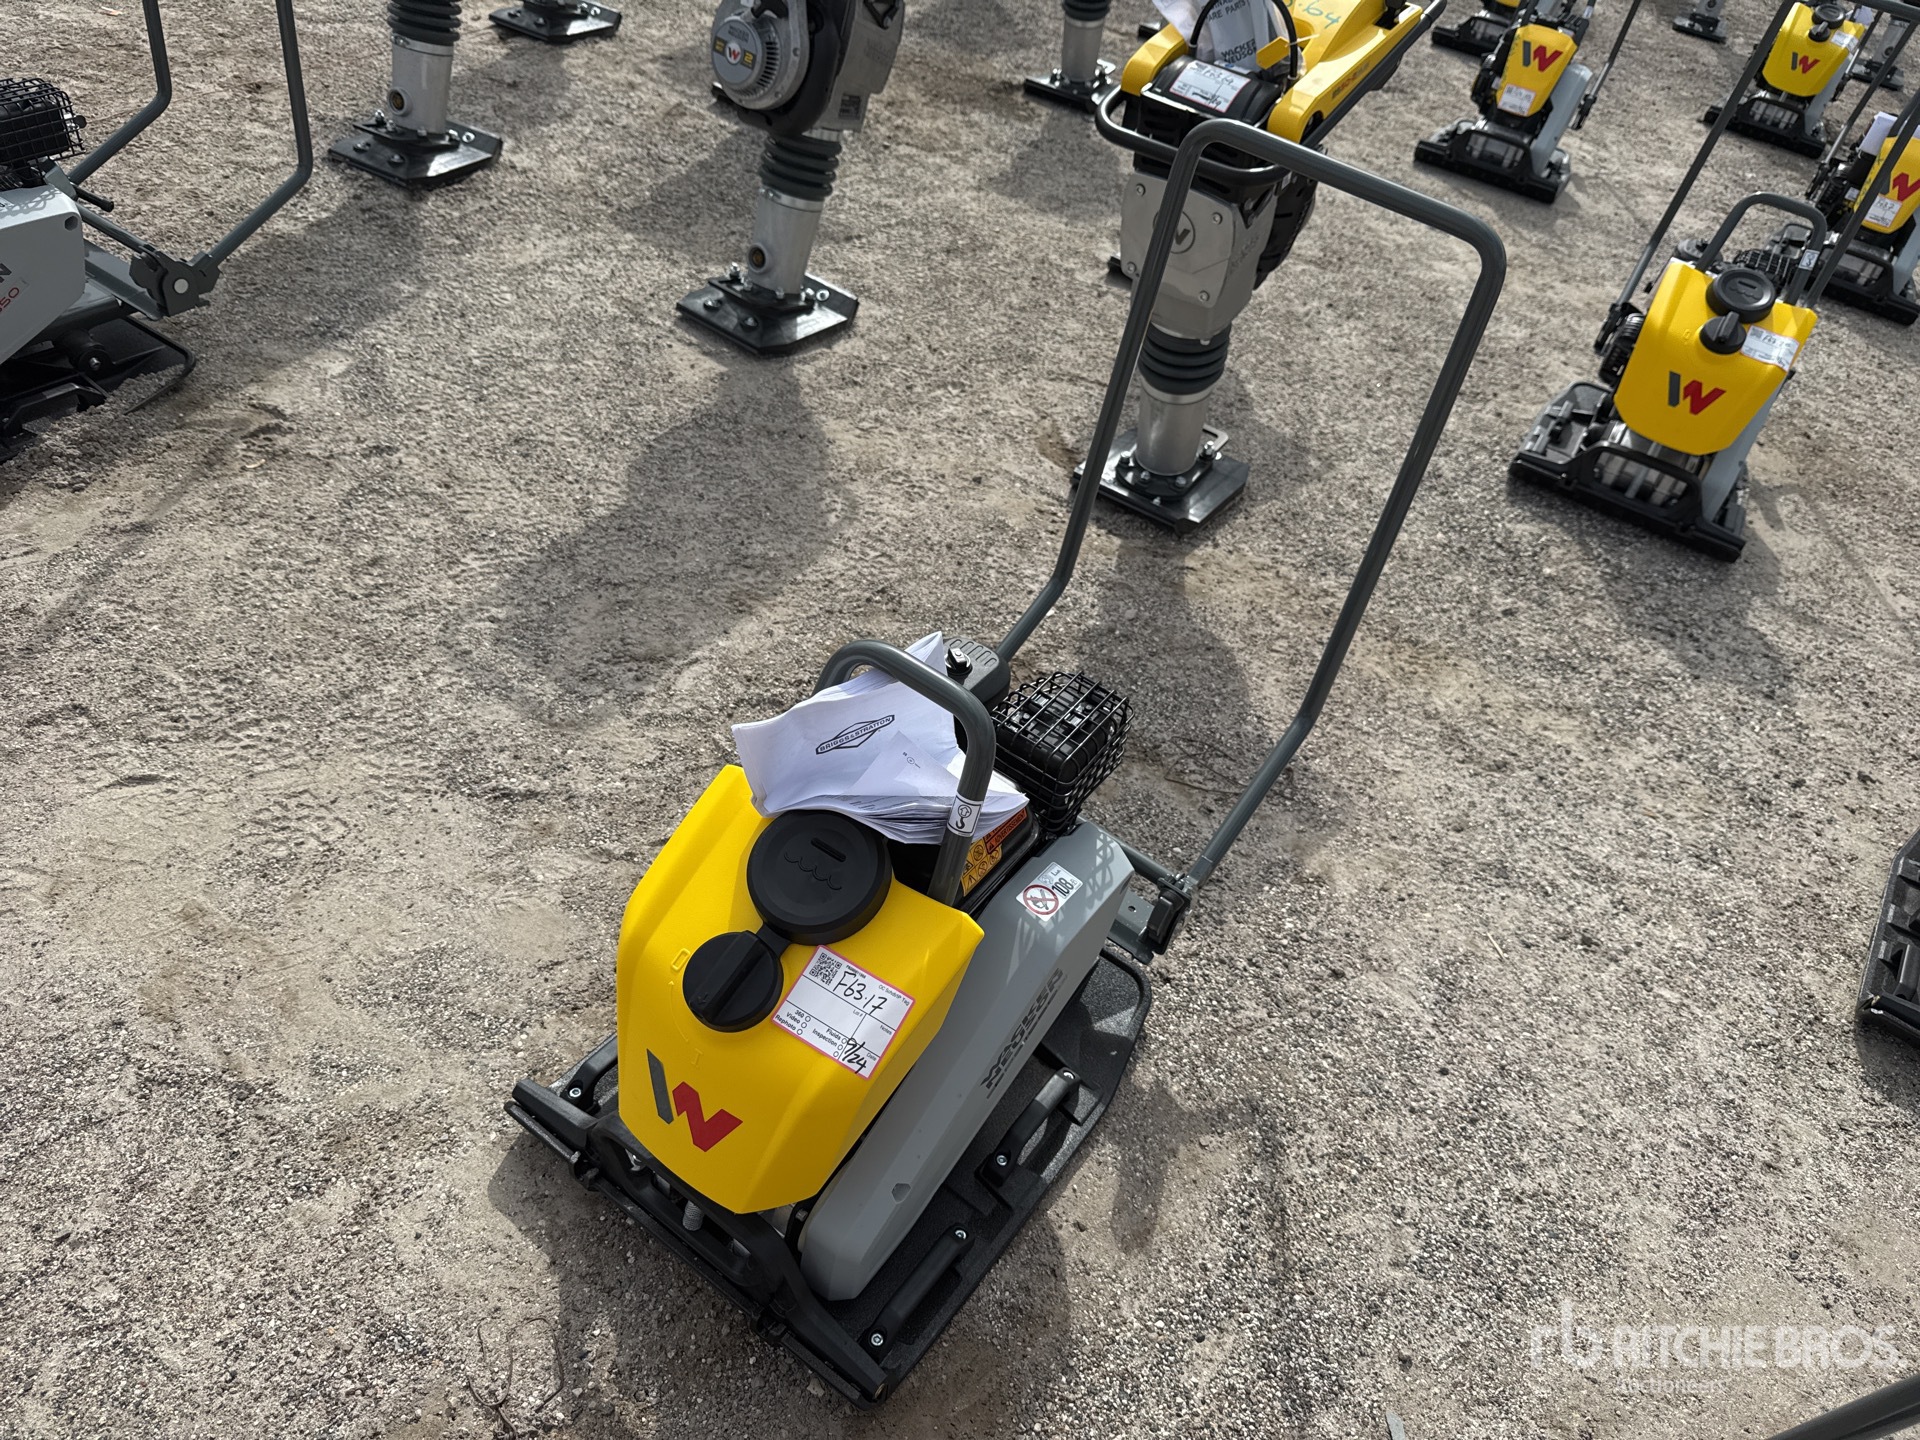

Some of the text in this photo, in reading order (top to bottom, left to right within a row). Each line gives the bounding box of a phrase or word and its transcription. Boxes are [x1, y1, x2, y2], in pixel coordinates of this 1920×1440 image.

[1052, 877, 1074, 897] 108
[786, 1011, 801, 1024] Video
[795, 1010, 805, 1019] 360
[775, 1014, 797, 1031] Rephoto
[880, 1025, 893, 1035] Notes
[812, 1028, 838, 1047] Inspection
[826, 1028, 841, 1041] Fluids
[842, 1037, 867, 1074] 9/24
